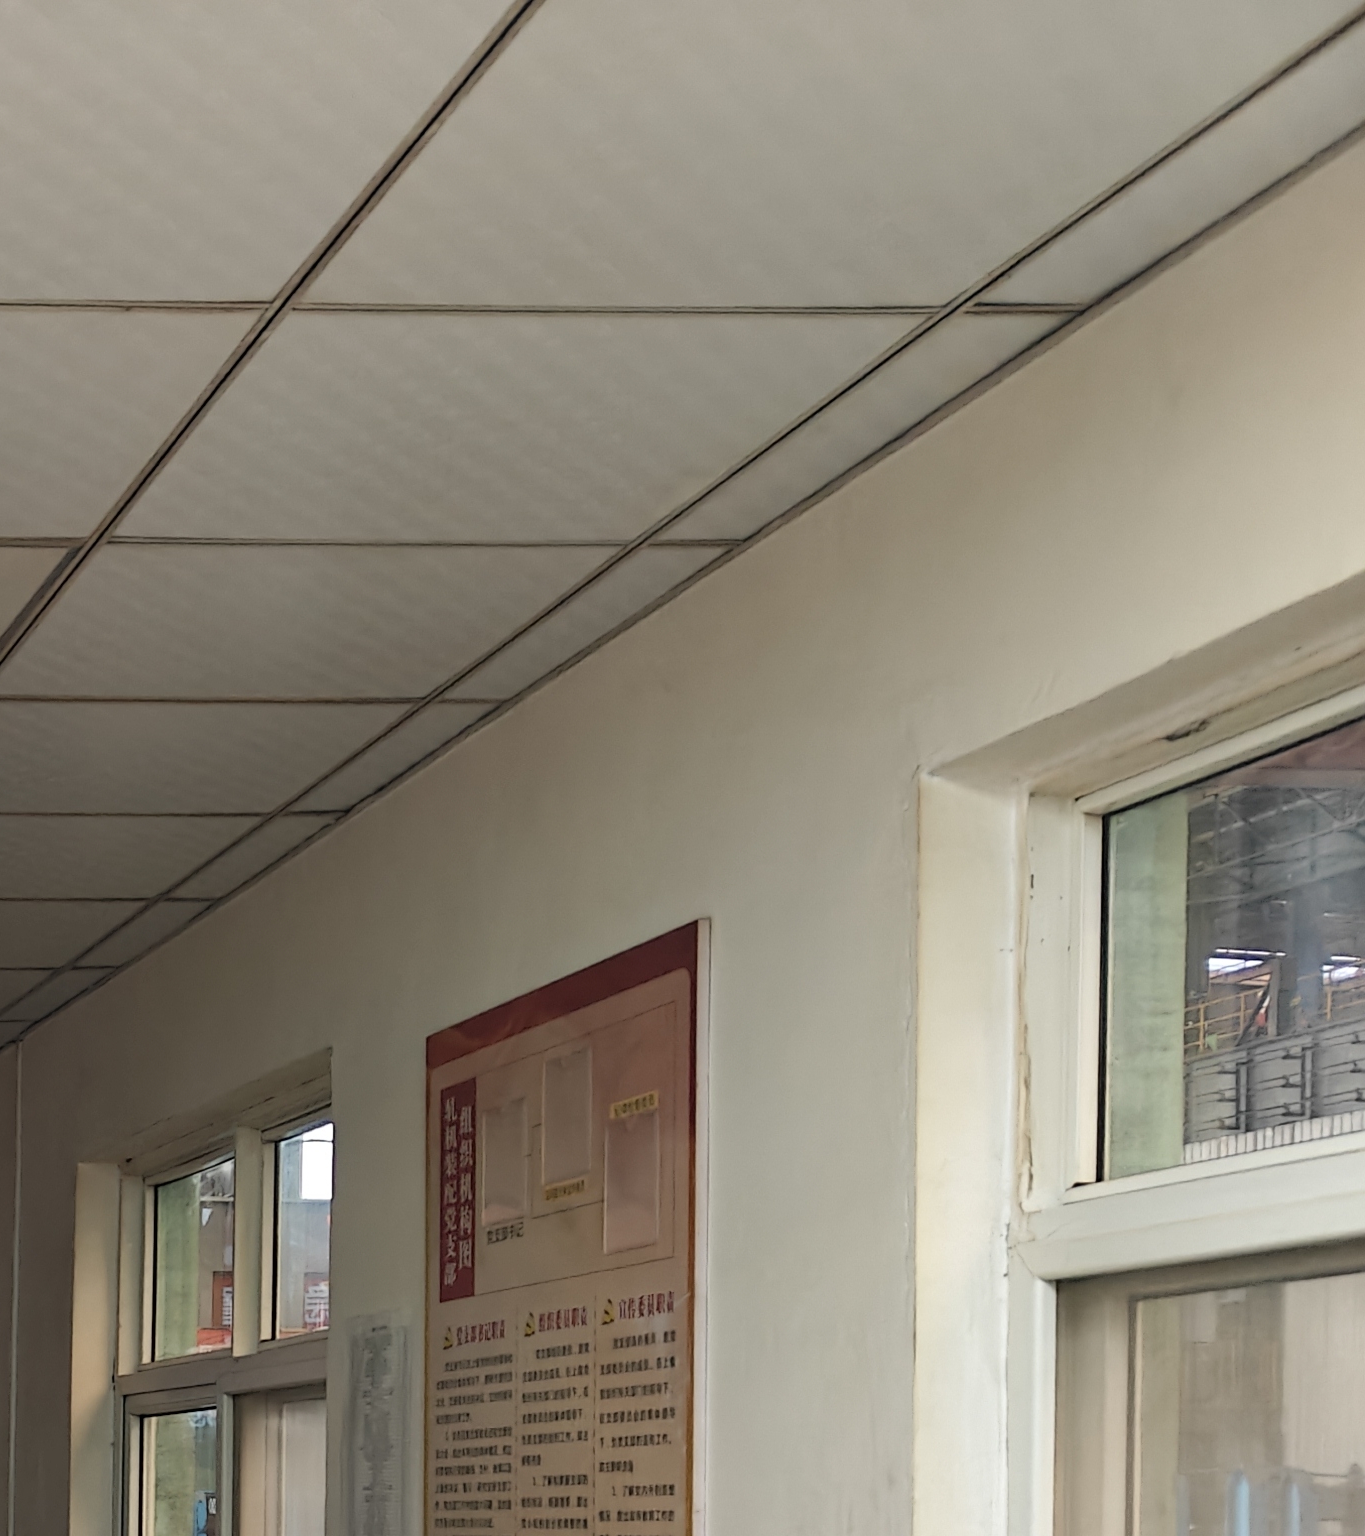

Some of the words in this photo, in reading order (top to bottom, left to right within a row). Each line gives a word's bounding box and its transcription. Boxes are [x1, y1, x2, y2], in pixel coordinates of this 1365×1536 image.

[444, 1096, 457, 1287] 轧机装配党支部
[459, 1105, 473, 1271] 组织机构图
[538, 1305, 588, 1332] 组织委员职责
[618, 1291, 676, 1320] 宣传委员职责
[456, 1319, 506, 1347] 党支部书记职责
